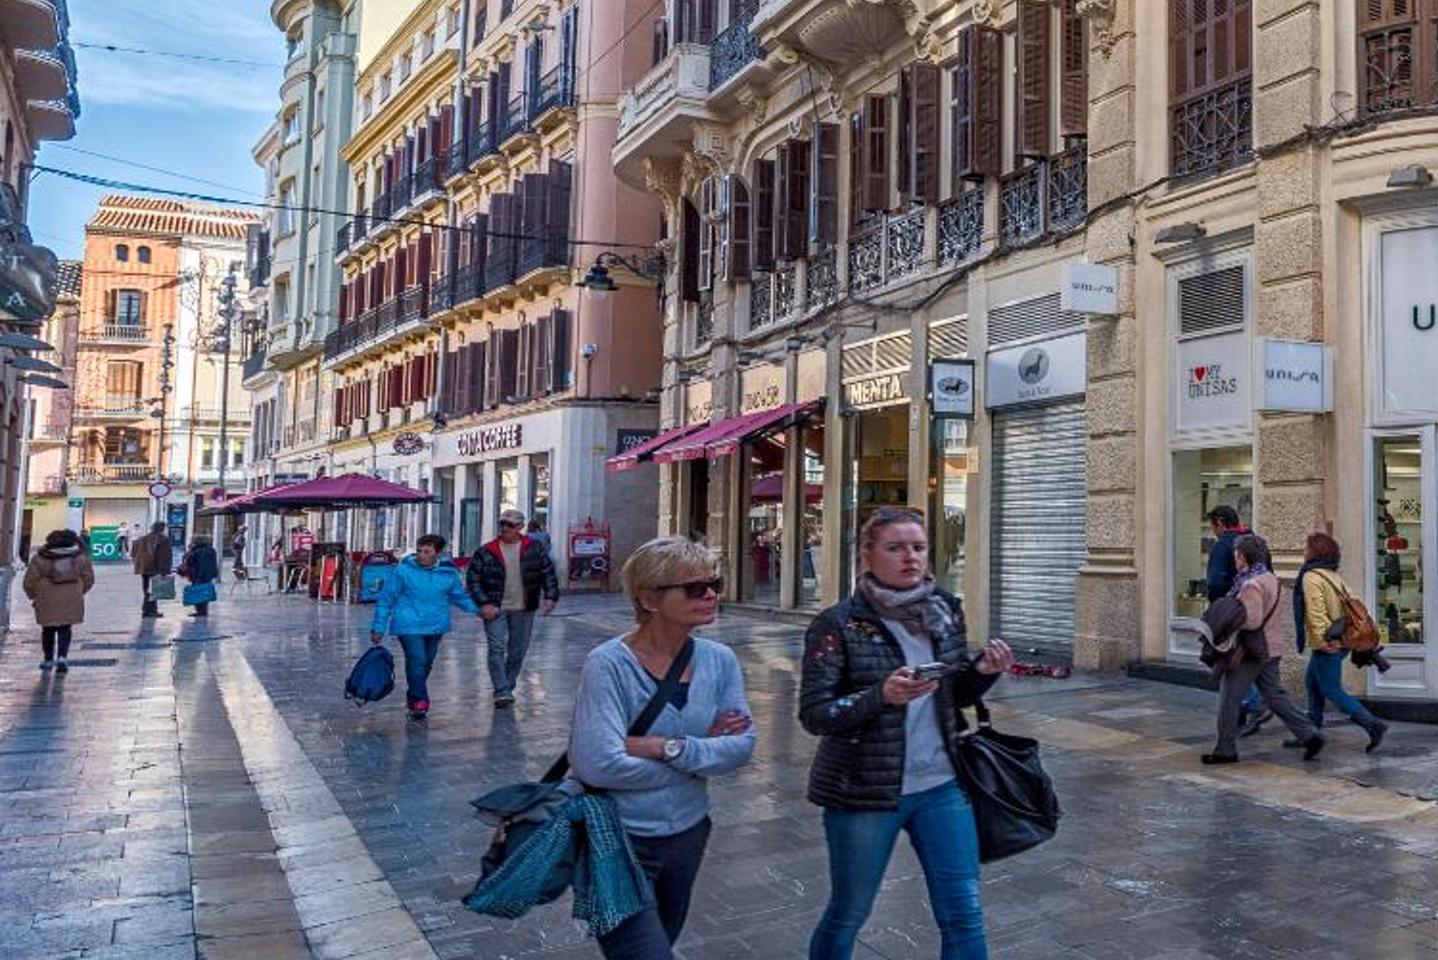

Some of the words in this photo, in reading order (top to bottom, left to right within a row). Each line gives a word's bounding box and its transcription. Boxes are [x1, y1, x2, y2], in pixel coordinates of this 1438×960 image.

[6, 292, 27, 307] A
[1207, 364, 1221, 380] MY
[851, 374, 904, 405] MENTA
[92, 543, 116, 557] 50
